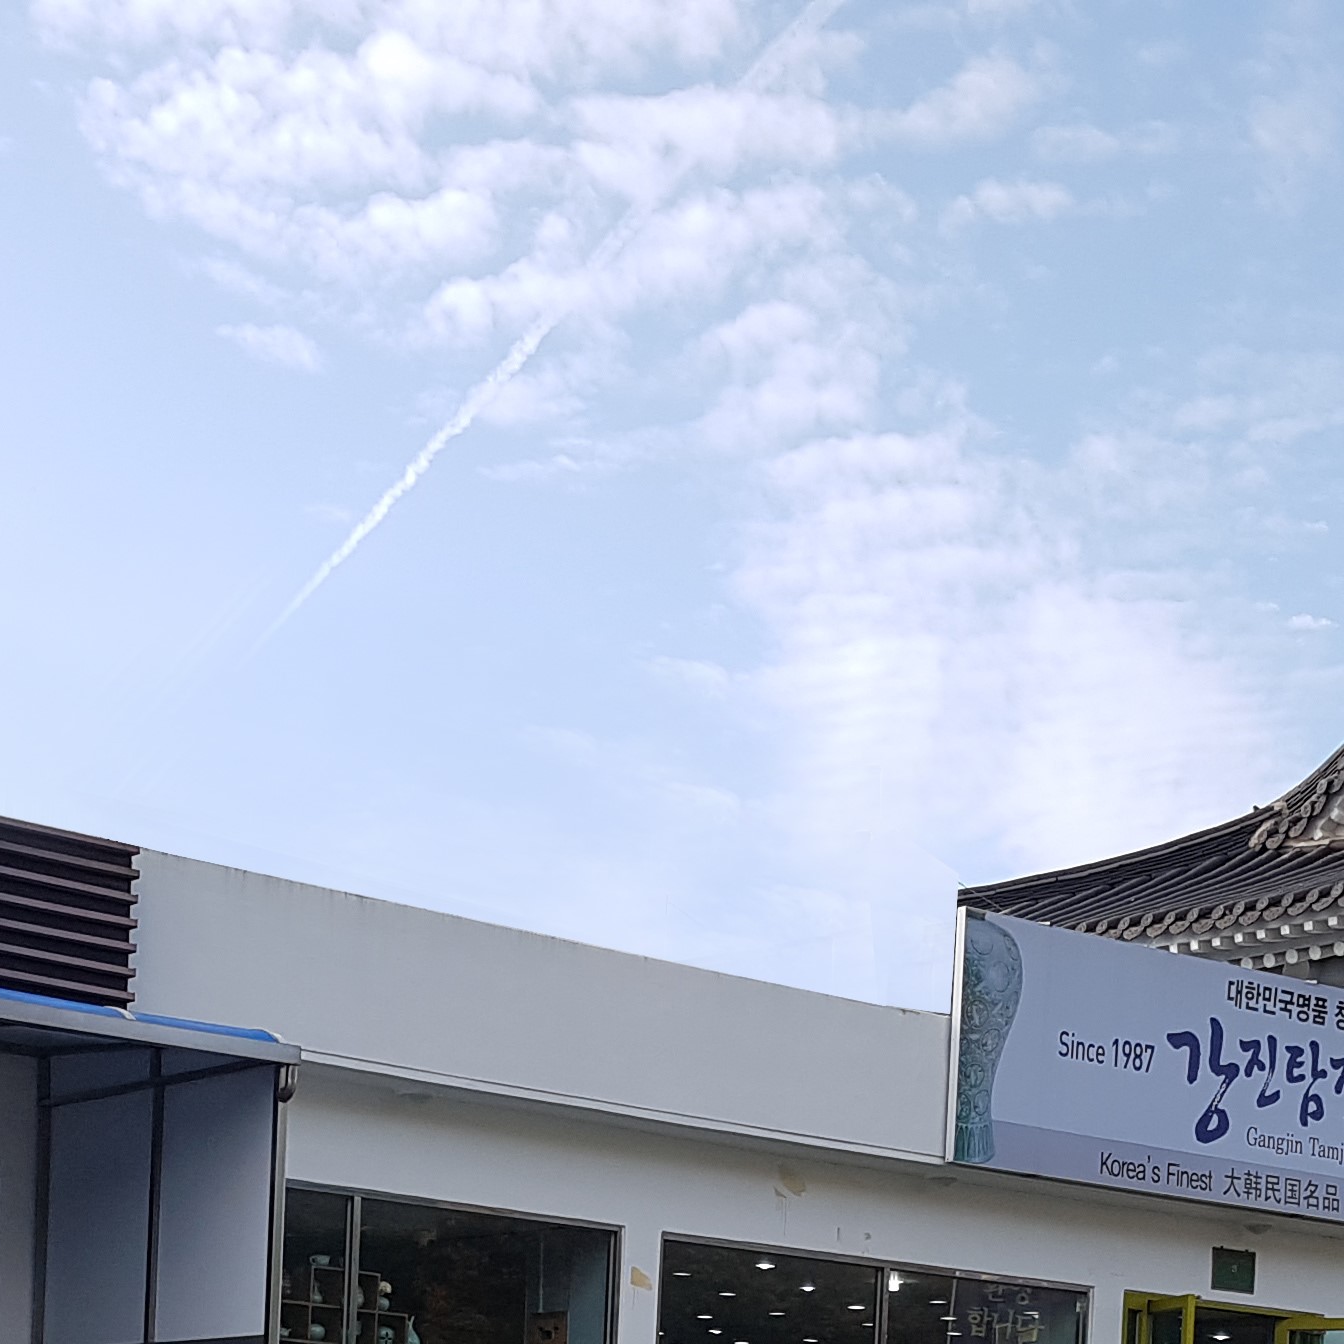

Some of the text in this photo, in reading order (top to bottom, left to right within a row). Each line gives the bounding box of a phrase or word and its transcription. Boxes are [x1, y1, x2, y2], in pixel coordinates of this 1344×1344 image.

[1227, 979, 1329, 1027] 대한민국명품
[1058, 1030, 1155, 1074] Since 1987
[1245, 1125, 1304, 1157] Gangjin
[1100, 1151, 1214, 1193] Korea's Finest
[1223, 1166, 1341, 1214] 大韩民国名品
